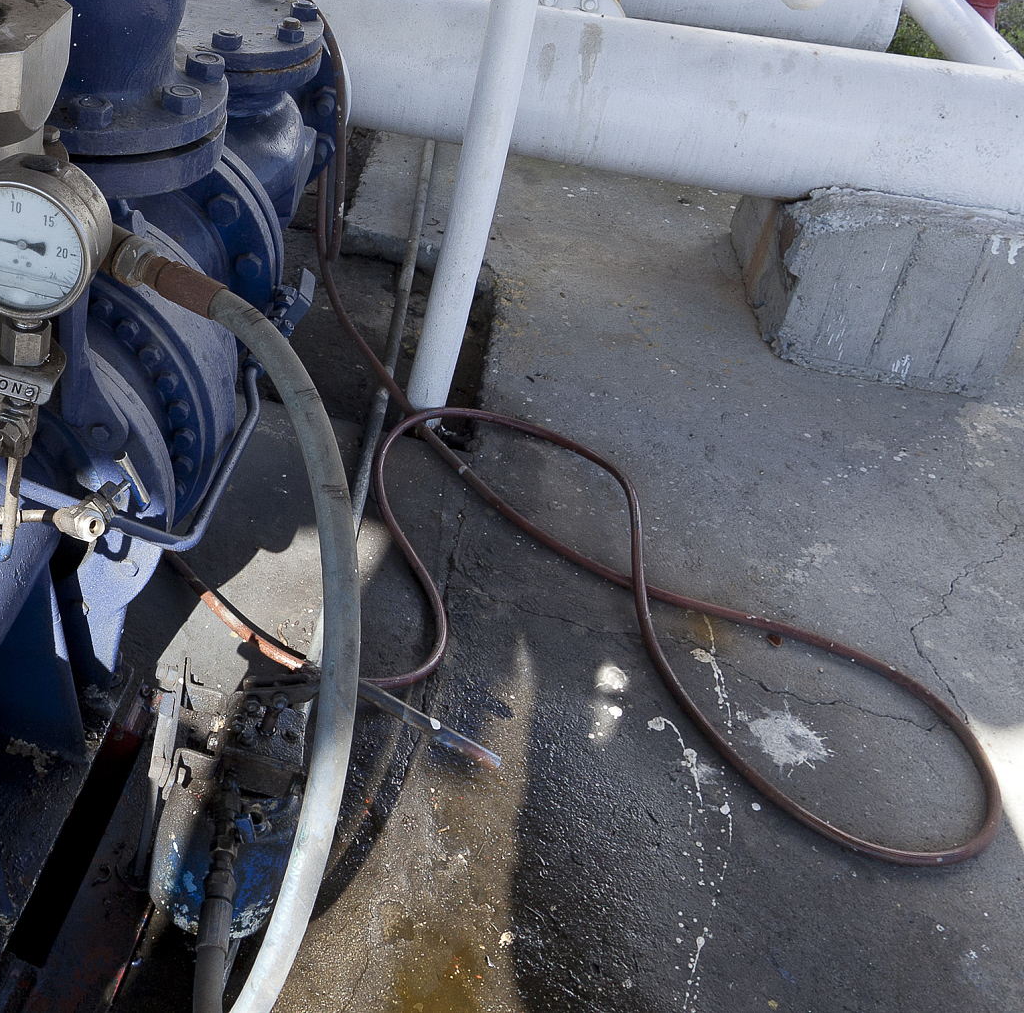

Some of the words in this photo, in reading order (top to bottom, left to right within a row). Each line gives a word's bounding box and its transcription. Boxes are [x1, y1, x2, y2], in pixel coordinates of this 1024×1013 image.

[11, 201, 21, 213] 10
[44, 215, 54, 227] 15
[56, 246, 68, 259] 20
